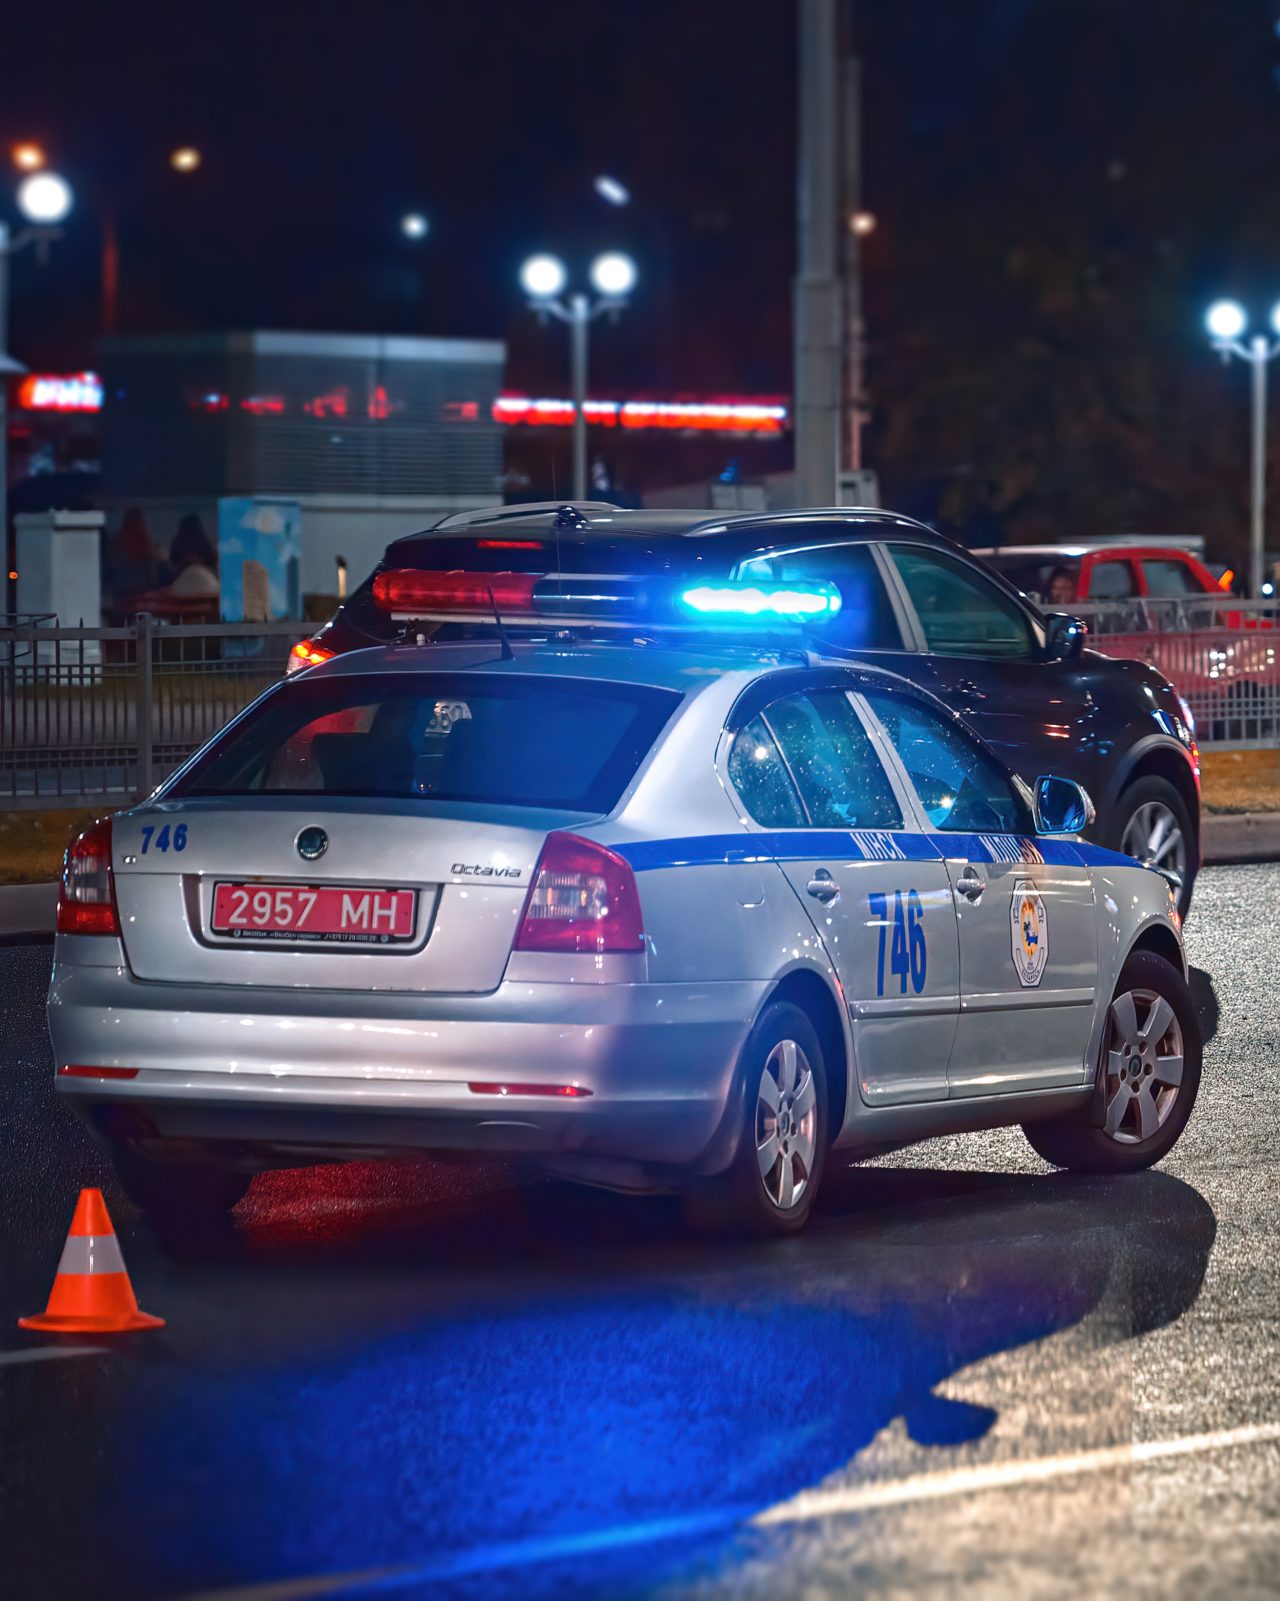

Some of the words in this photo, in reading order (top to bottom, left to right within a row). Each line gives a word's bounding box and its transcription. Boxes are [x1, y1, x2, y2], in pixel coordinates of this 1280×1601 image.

[141, 823, 189, 855] 746
[451, 863, 522, 878] Octavia
[228, 890, 318, 928] 2957
[867, 888, 927, 997] 746
